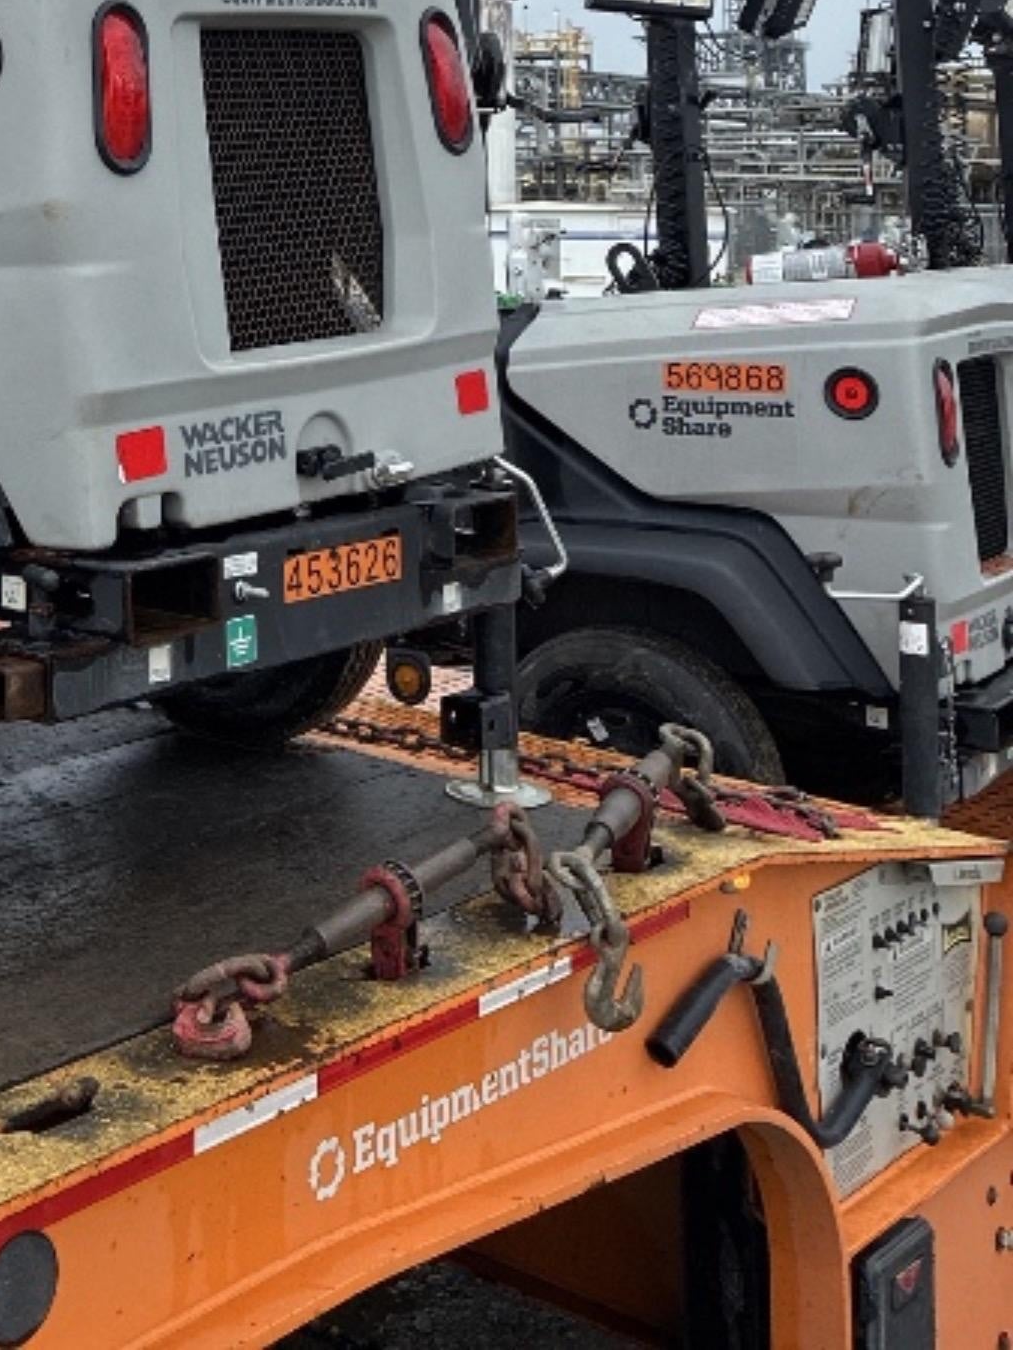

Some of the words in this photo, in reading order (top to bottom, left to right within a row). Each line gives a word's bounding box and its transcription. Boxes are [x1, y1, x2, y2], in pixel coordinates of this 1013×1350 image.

[667, 362, 784, 391] 569868
[661, 395, 795, 420] Equipment
[180, 410, 285, 451] WACKER
[661, 417, 732, 438] Share
[184, 435, 287, 478] NEUSON
[287, 539, 398, 596] 453626
